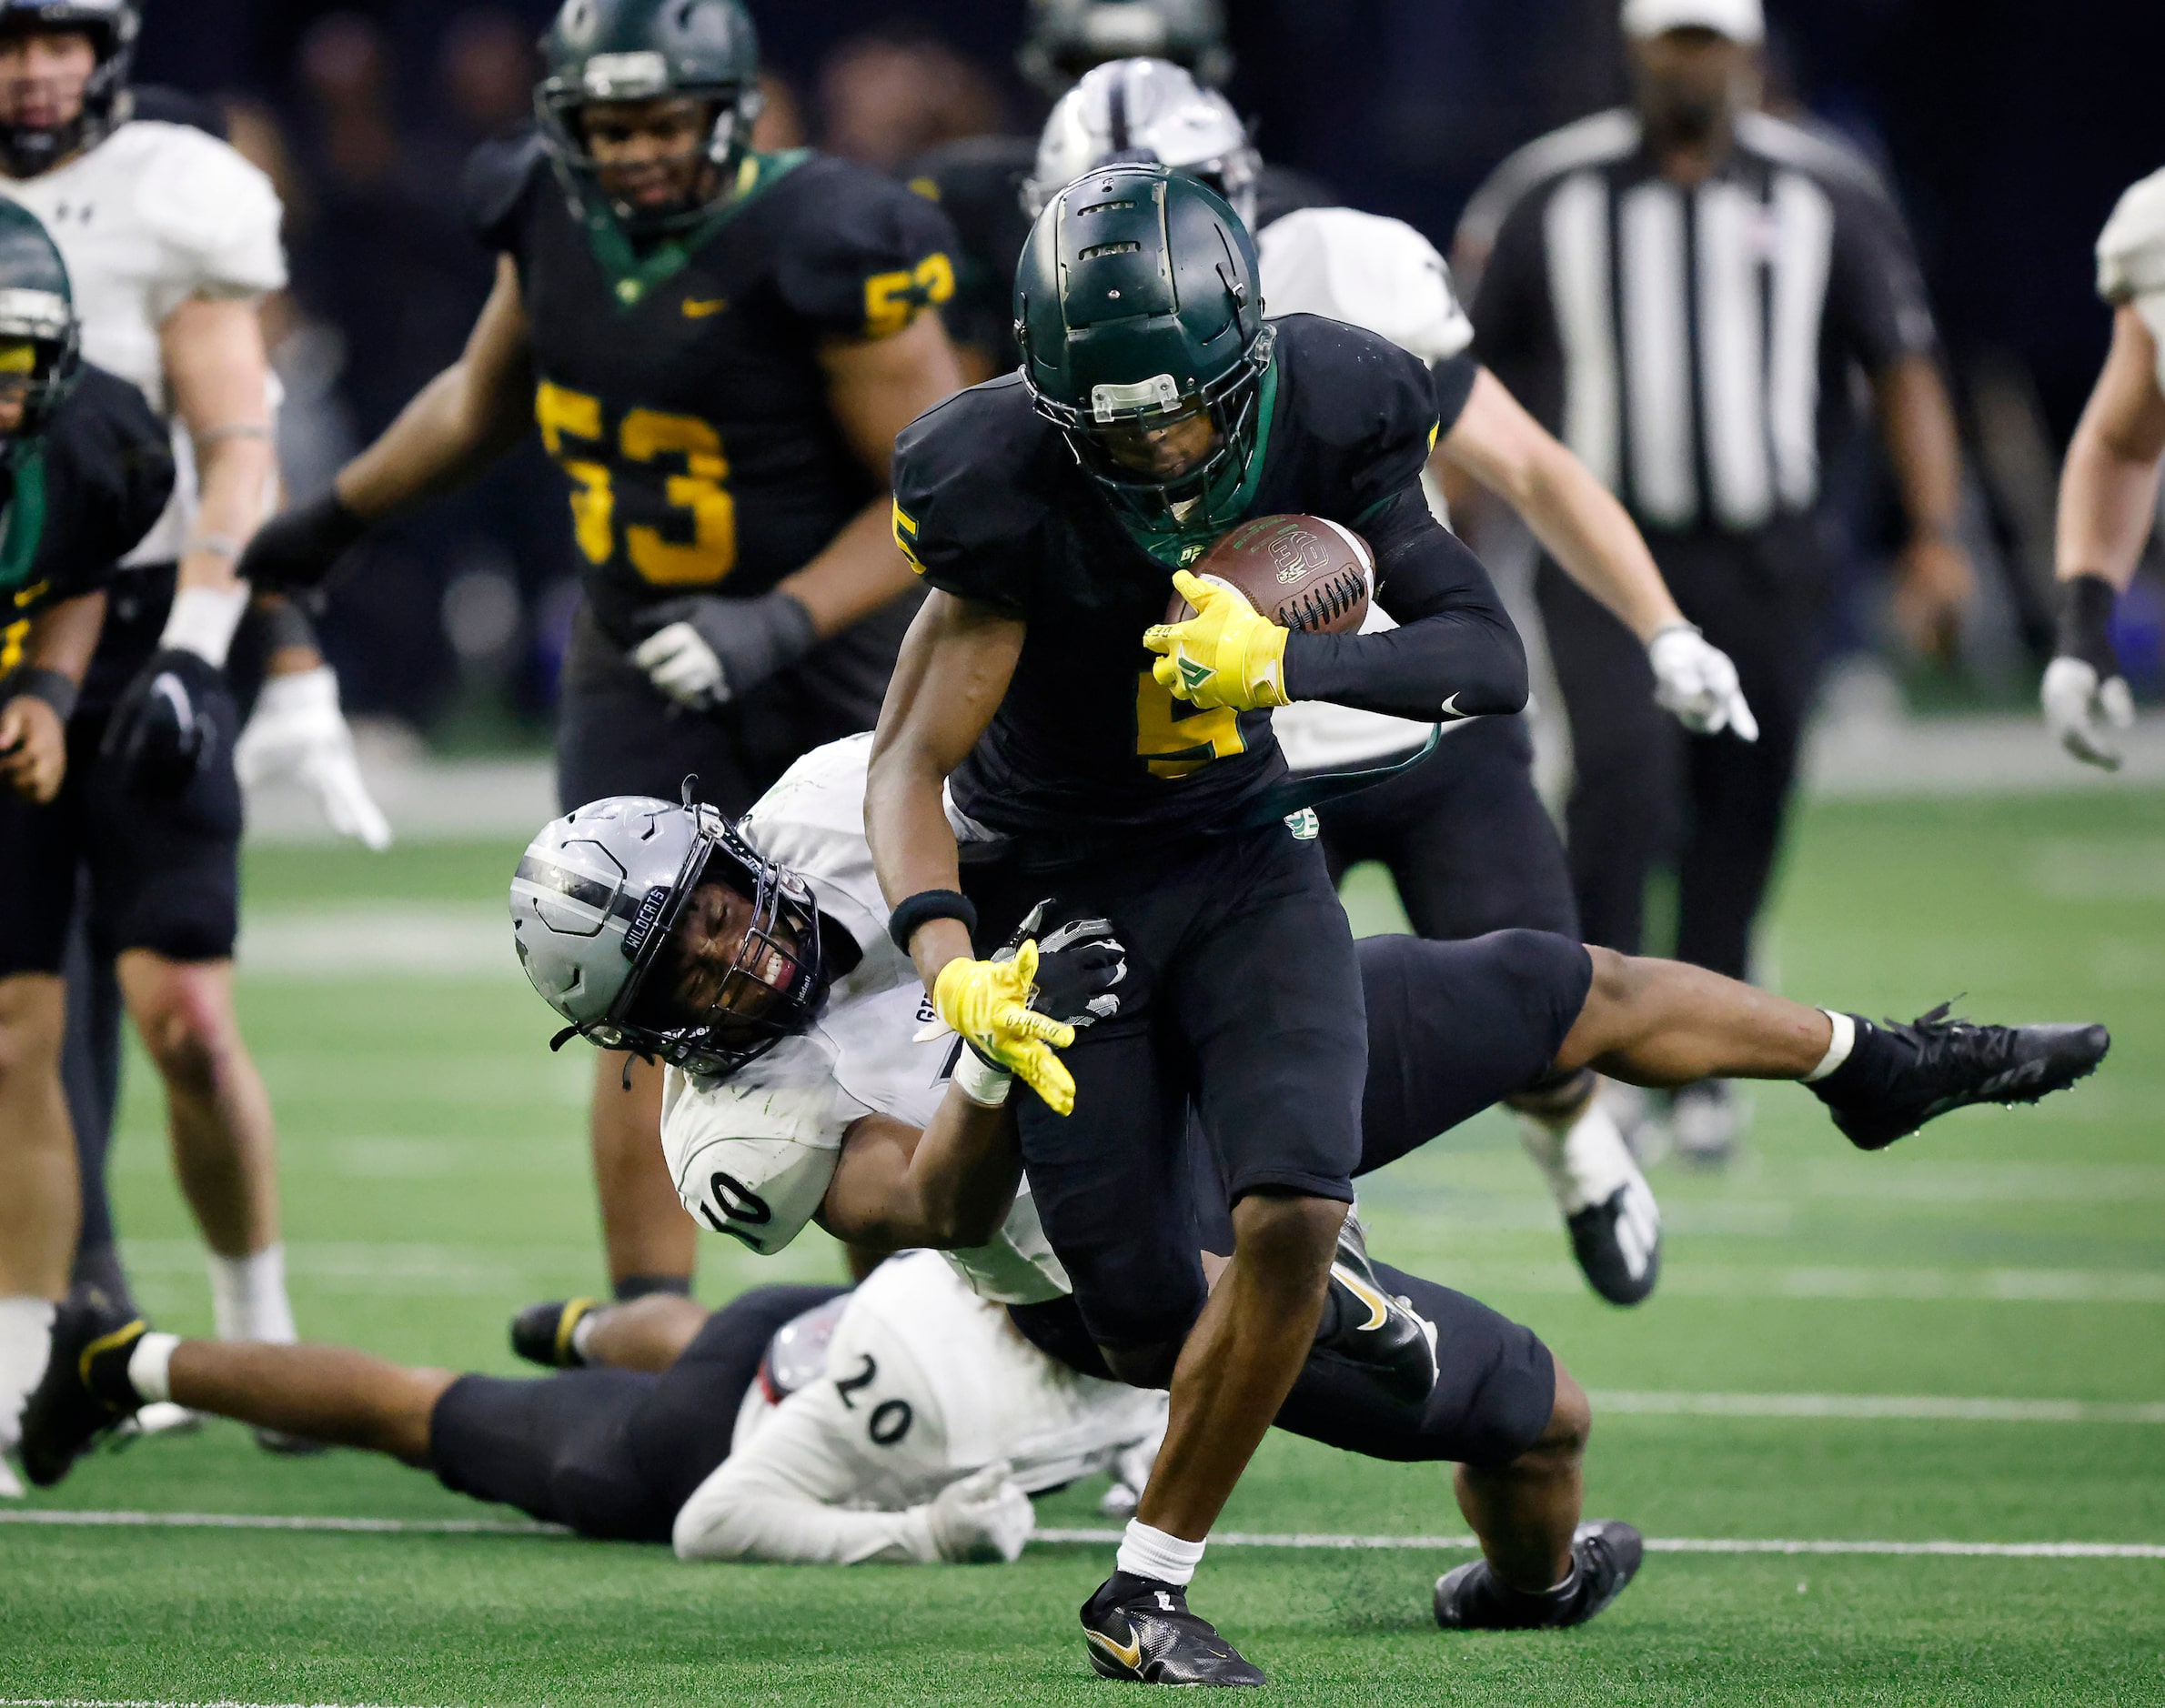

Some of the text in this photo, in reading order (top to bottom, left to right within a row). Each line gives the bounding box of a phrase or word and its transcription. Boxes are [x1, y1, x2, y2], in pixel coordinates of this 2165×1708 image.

[535, 377, 734, 585] 53
[625, 888, 665, 949] WILDCATS
[700, 1171, 771, 1250] 10
[835, 1352, 912, 1445] 20
